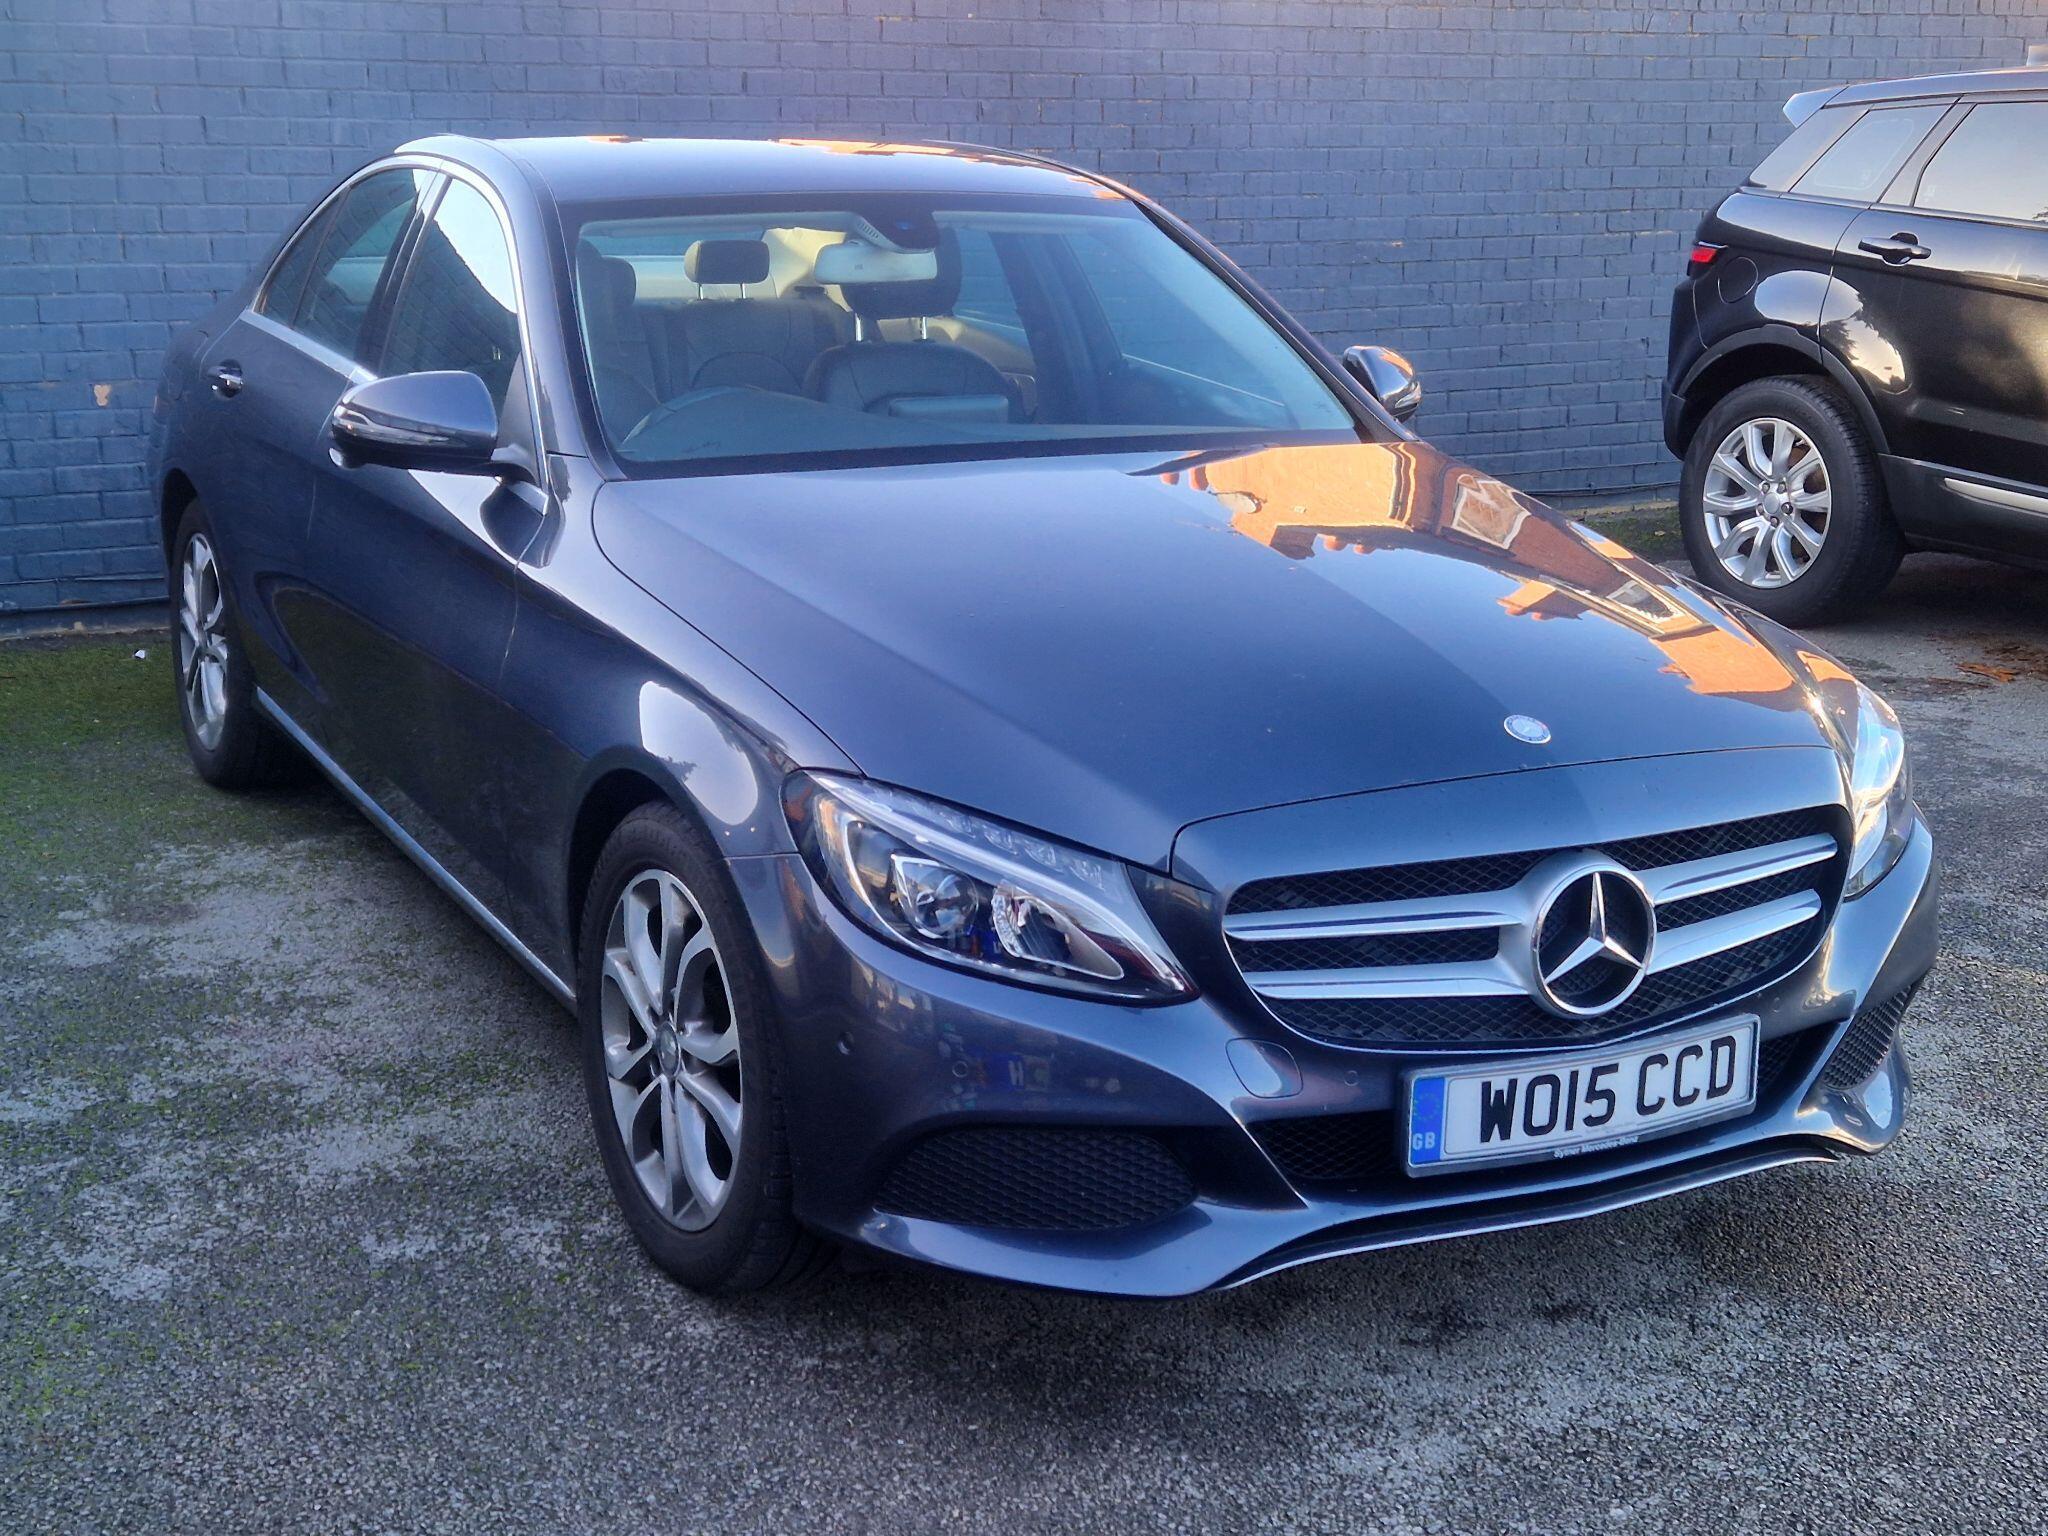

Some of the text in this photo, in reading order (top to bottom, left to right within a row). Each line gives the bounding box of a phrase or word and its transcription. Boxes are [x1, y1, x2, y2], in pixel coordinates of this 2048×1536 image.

[1480, 1035, 1736, 1143] WO15 CCD
[1412, 1131, 1436, 1150] GB
